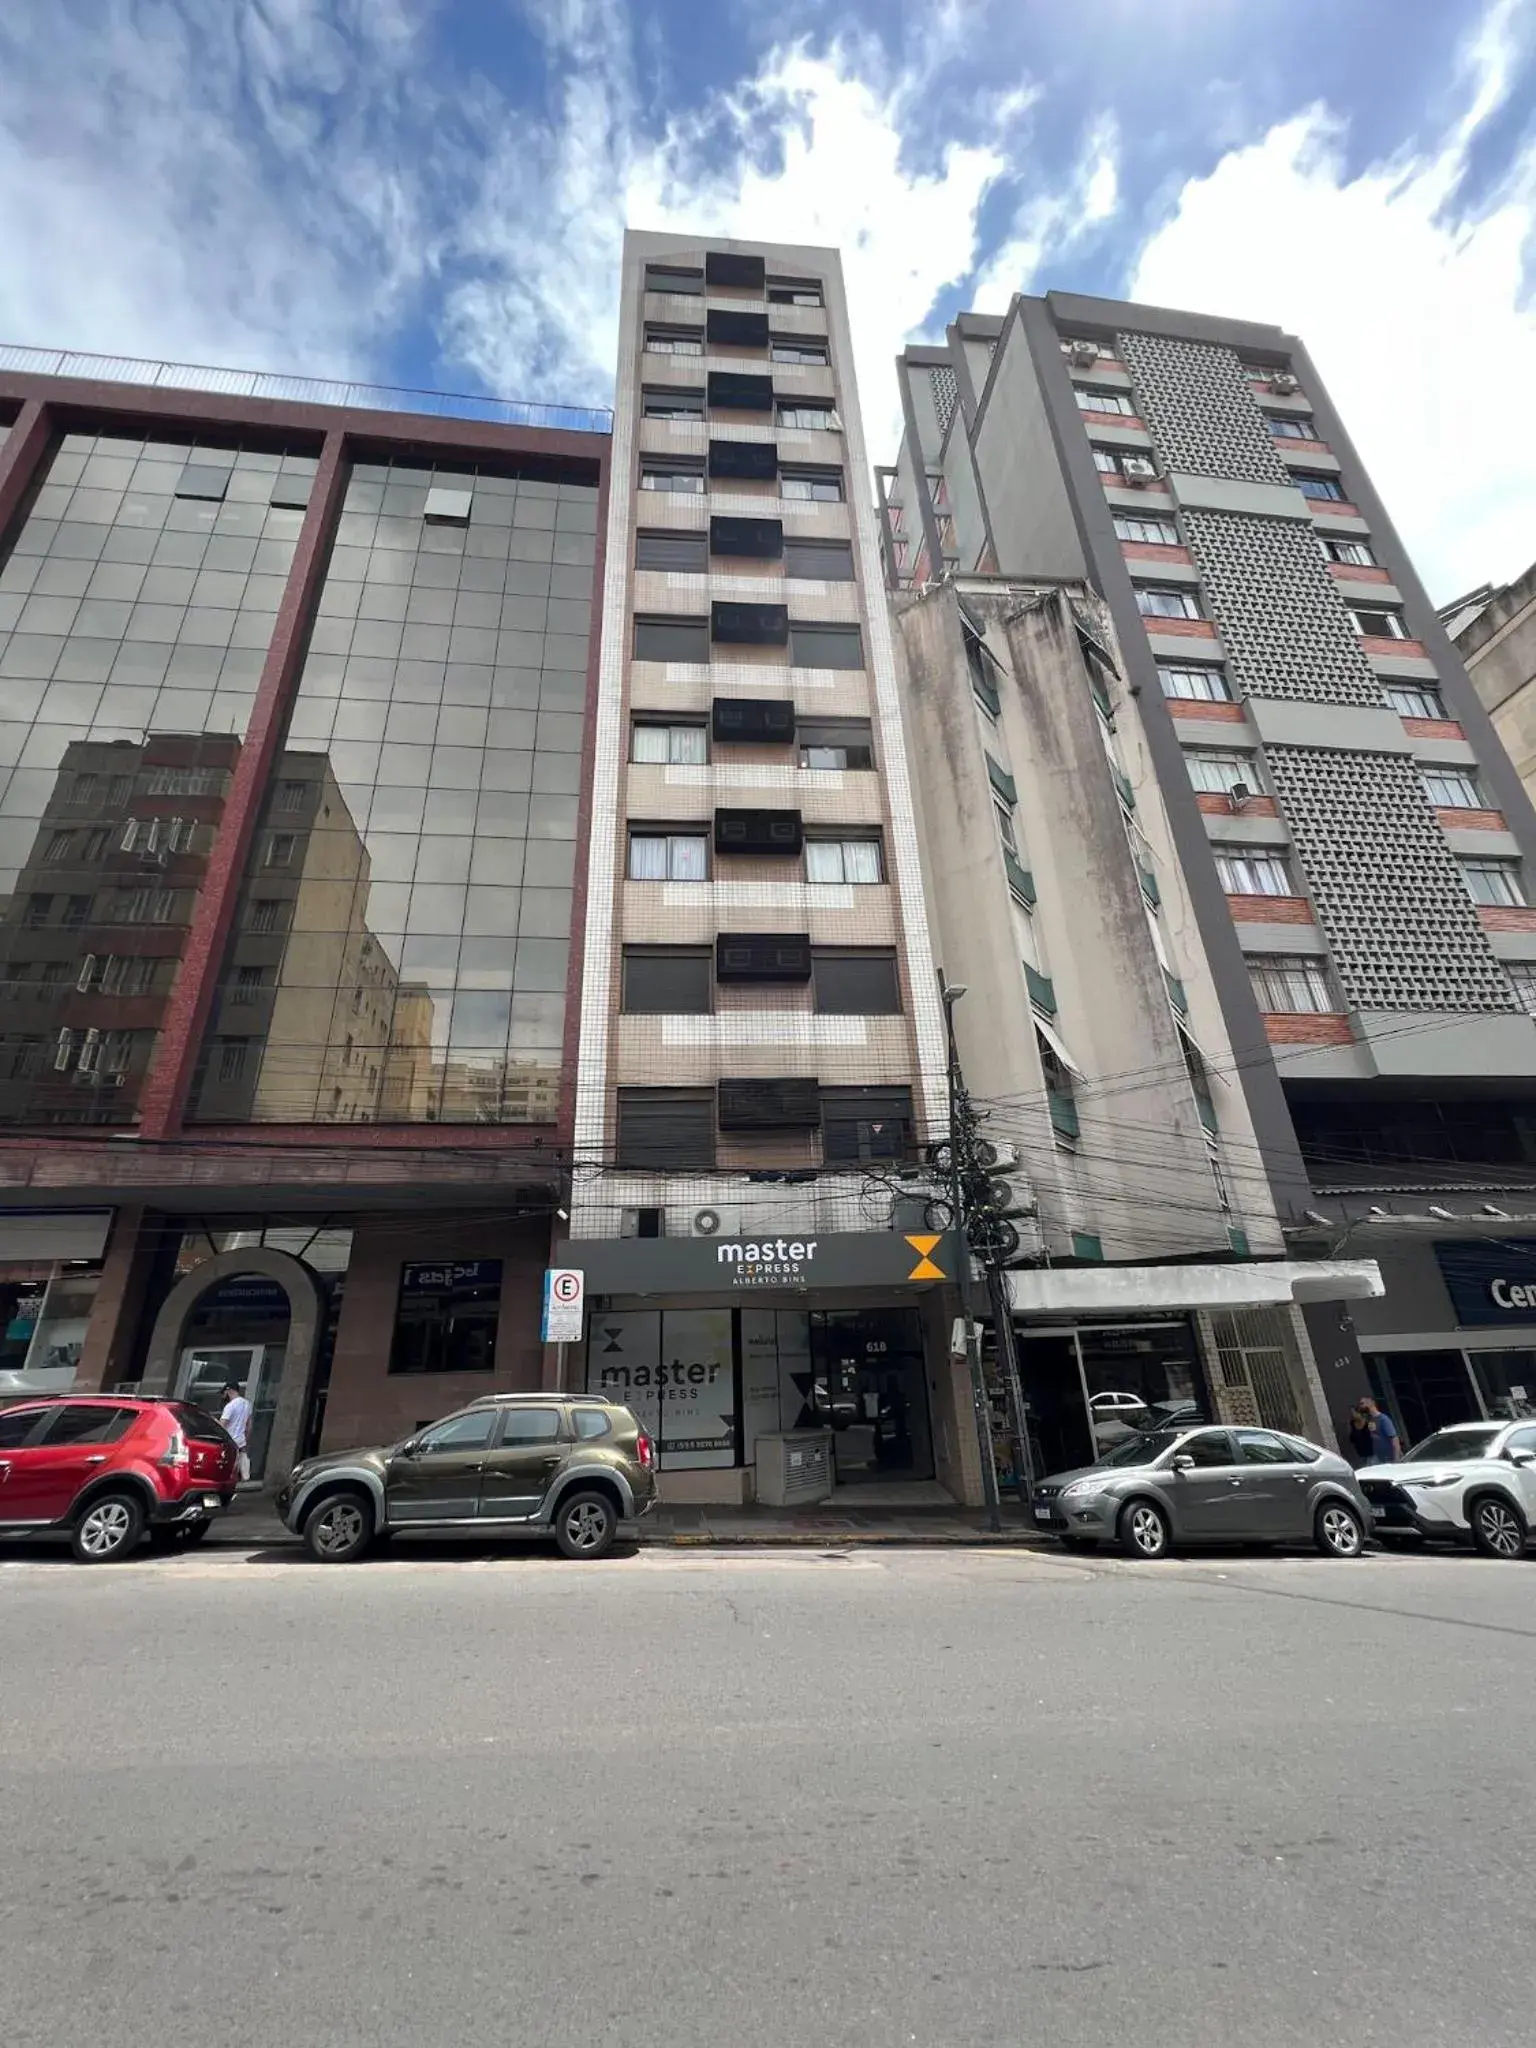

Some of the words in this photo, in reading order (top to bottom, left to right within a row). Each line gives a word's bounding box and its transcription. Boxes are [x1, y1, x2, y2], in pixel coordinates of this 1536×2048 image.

[717, 1239, 817, 1262] master
[562, 1279, 572, 1295] E
[733, 1276, 777, 1284] ALBERTO
[782, 1275, 805, 1283] BINS
[601, 1359, 720, 1388] master
